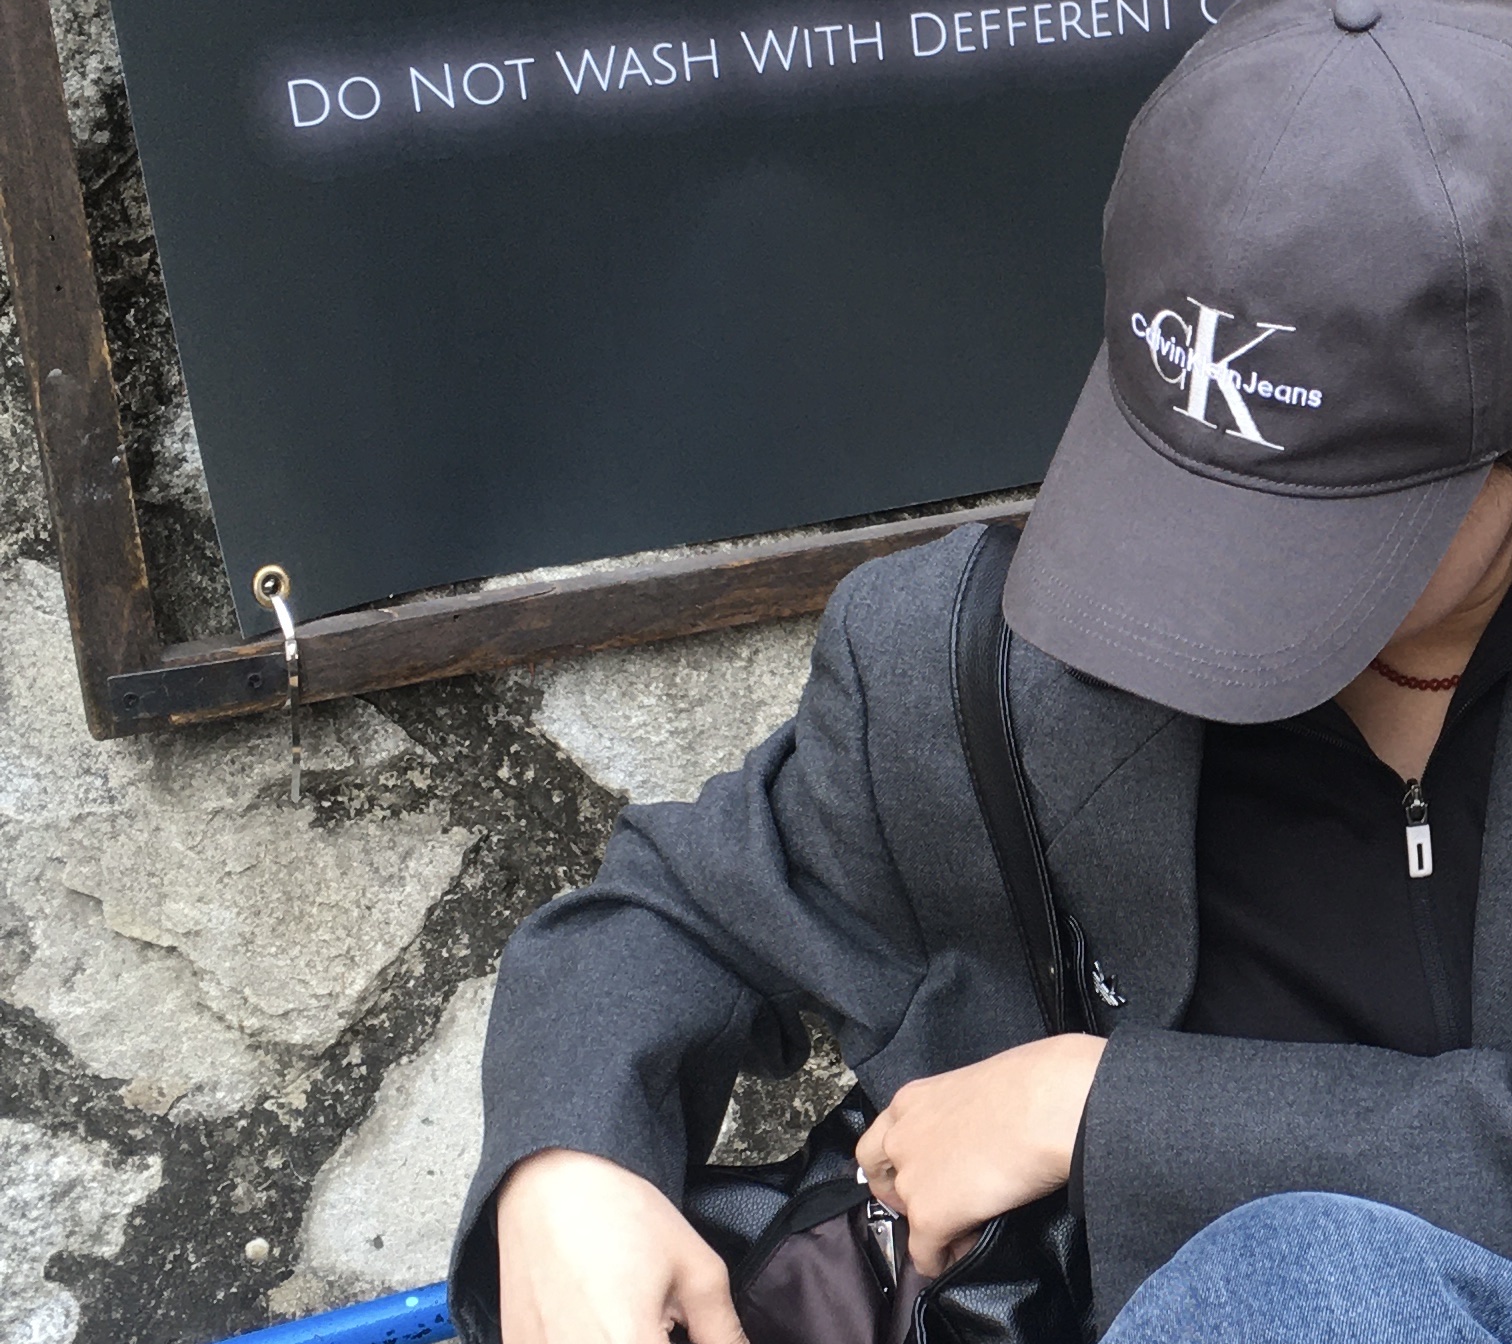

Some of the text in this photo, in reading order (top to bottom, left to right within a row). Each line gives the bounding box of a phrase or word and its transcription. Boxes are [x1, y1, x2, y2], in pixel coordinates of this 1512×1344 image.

[286, 76, 382, 128] DO
[408, 58, 535, 113] NOT
[555, 38, 720, 95] WASH
[740, 21, 884, 74] WITH
[1242, 371, 1323, 408] Jeans
